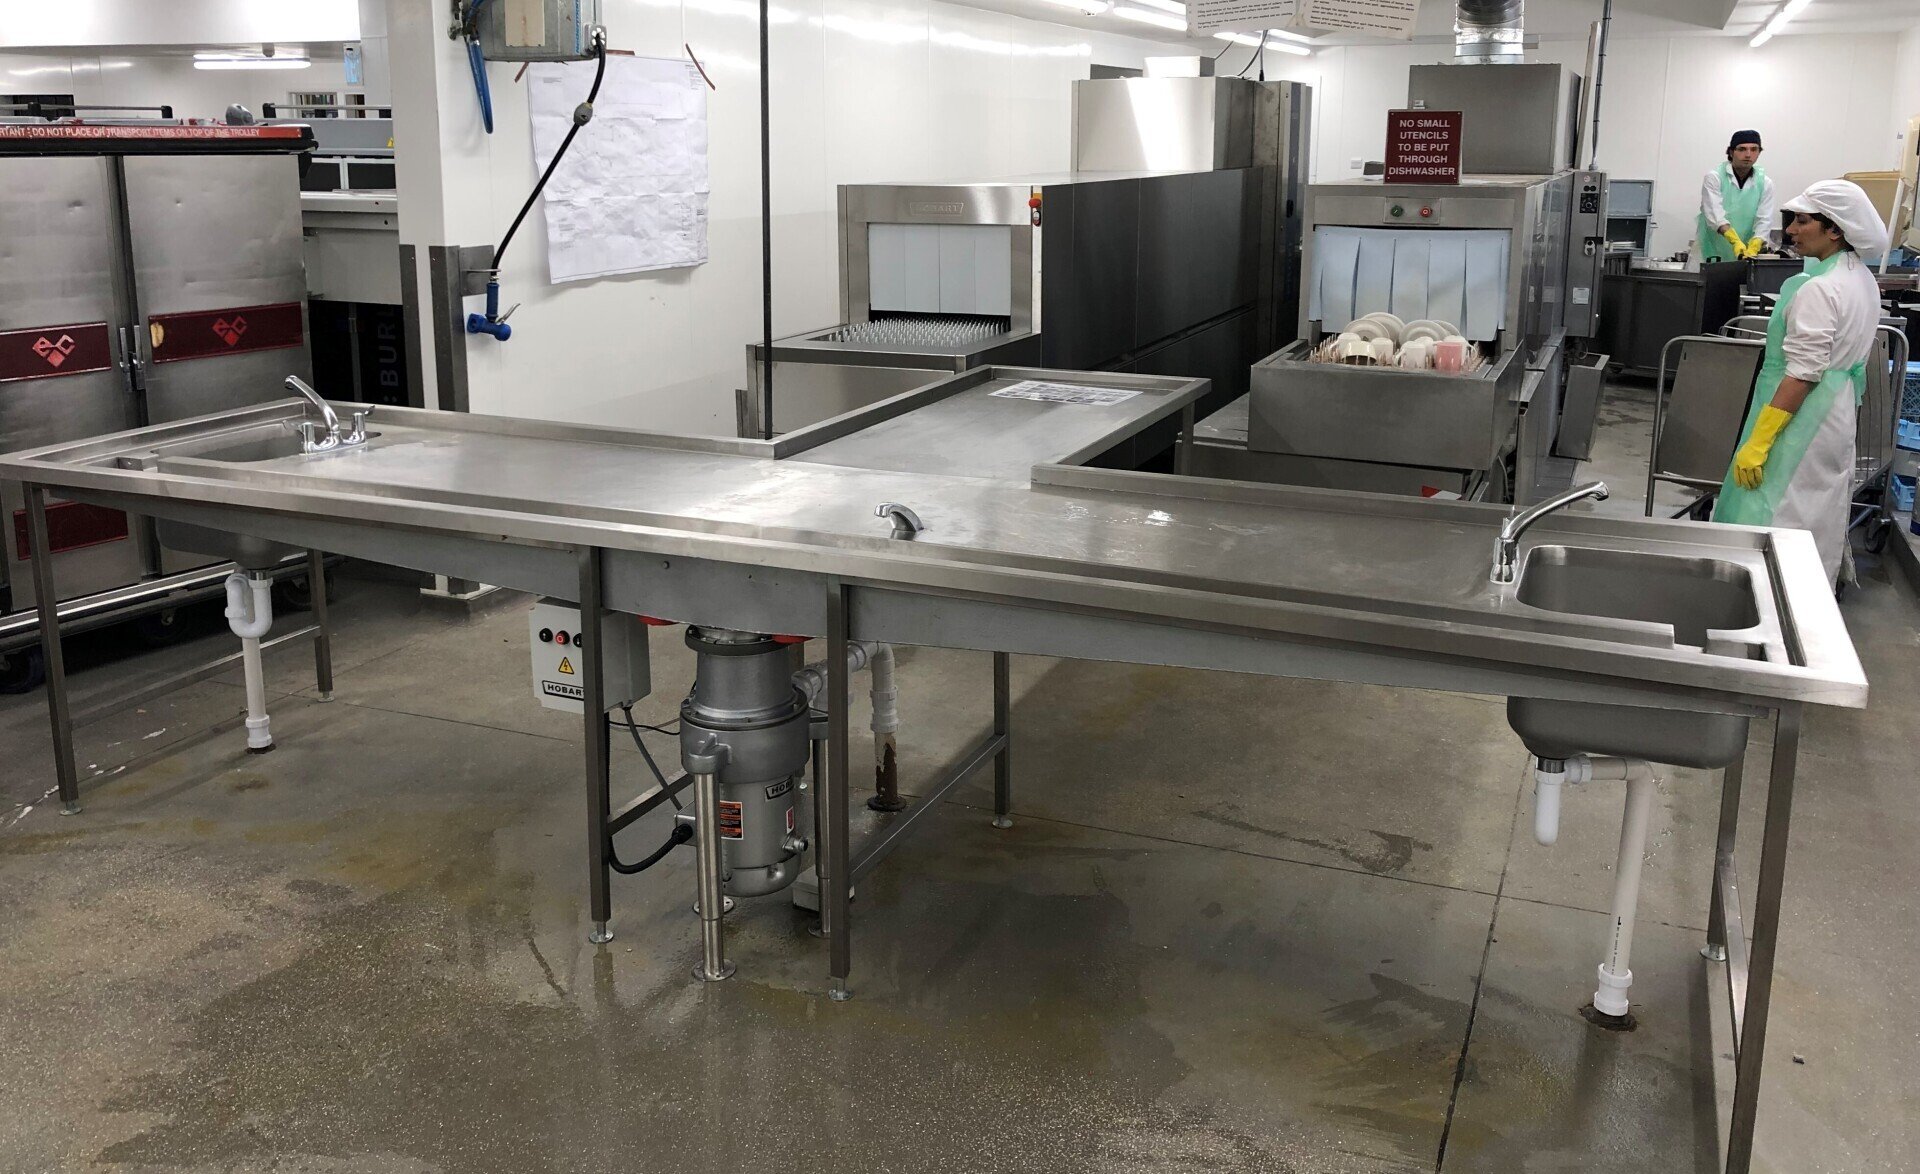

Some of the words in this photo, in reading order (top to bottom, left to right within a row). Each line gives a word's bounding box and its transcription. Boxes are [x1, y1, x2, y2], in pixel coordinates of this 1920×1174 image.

[1399, 119, 1415, 128] NO
[1417, 119, 1451, 128] SMALL
[32, 127, 45, 136] DO
[46, 127, 63, 136] NOT
[66, 127, 91, 136] PLACE
[92, 127, 105, 136] OR
[106, 127, 153, 137] TRANSPORT
[153, 128, 175, 137] ITEMS
[176, 128, 188, 137] ON
[188, 128, 202, 137] TOP
[204, 128, 215, 137] OF
[216, 128, 229, 137] THE
[230, 128, 260, 137] TROLLEY
[1400, 131, 1449, 140] UTENCILS
[1398, 143, 1411, 151] TO
[1414, 143, 1427, 152] BE
[1429, 143, 1450, 152] PUT
[1398, 155, 1448, 163] THROUGH
[1388, 166, 1456, 176] DISHWASHER
[547, 683, 584, 696] HOBAR
